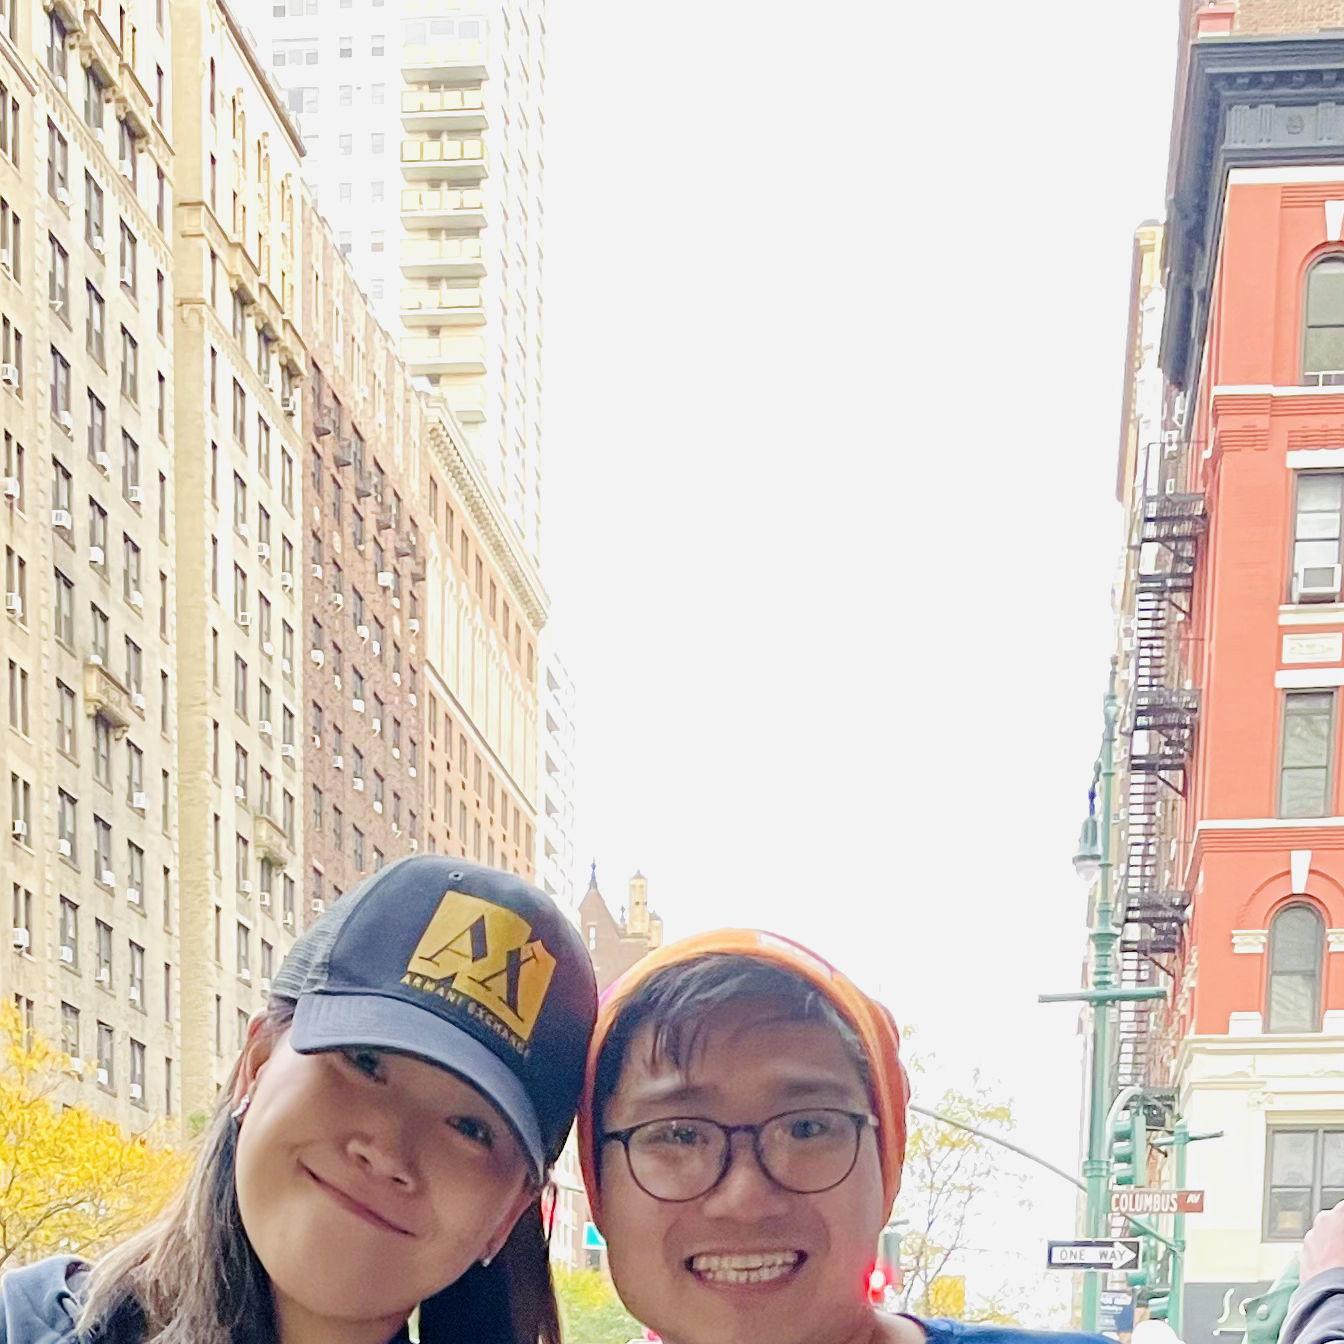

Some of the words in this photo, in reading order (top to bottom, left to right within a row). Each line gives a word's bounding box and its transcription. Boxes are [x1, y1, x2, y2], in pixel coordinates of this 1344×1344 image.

[399, 973, 463, 1006] ARMANI
[1111, 1193, 1178, 1212] COLUMBUS
[1186, 1193, 1201, 1204] AV
[1059, 1248, 1085, 1261] ONE
[1099, 1248, 1126, 1261] WAY
